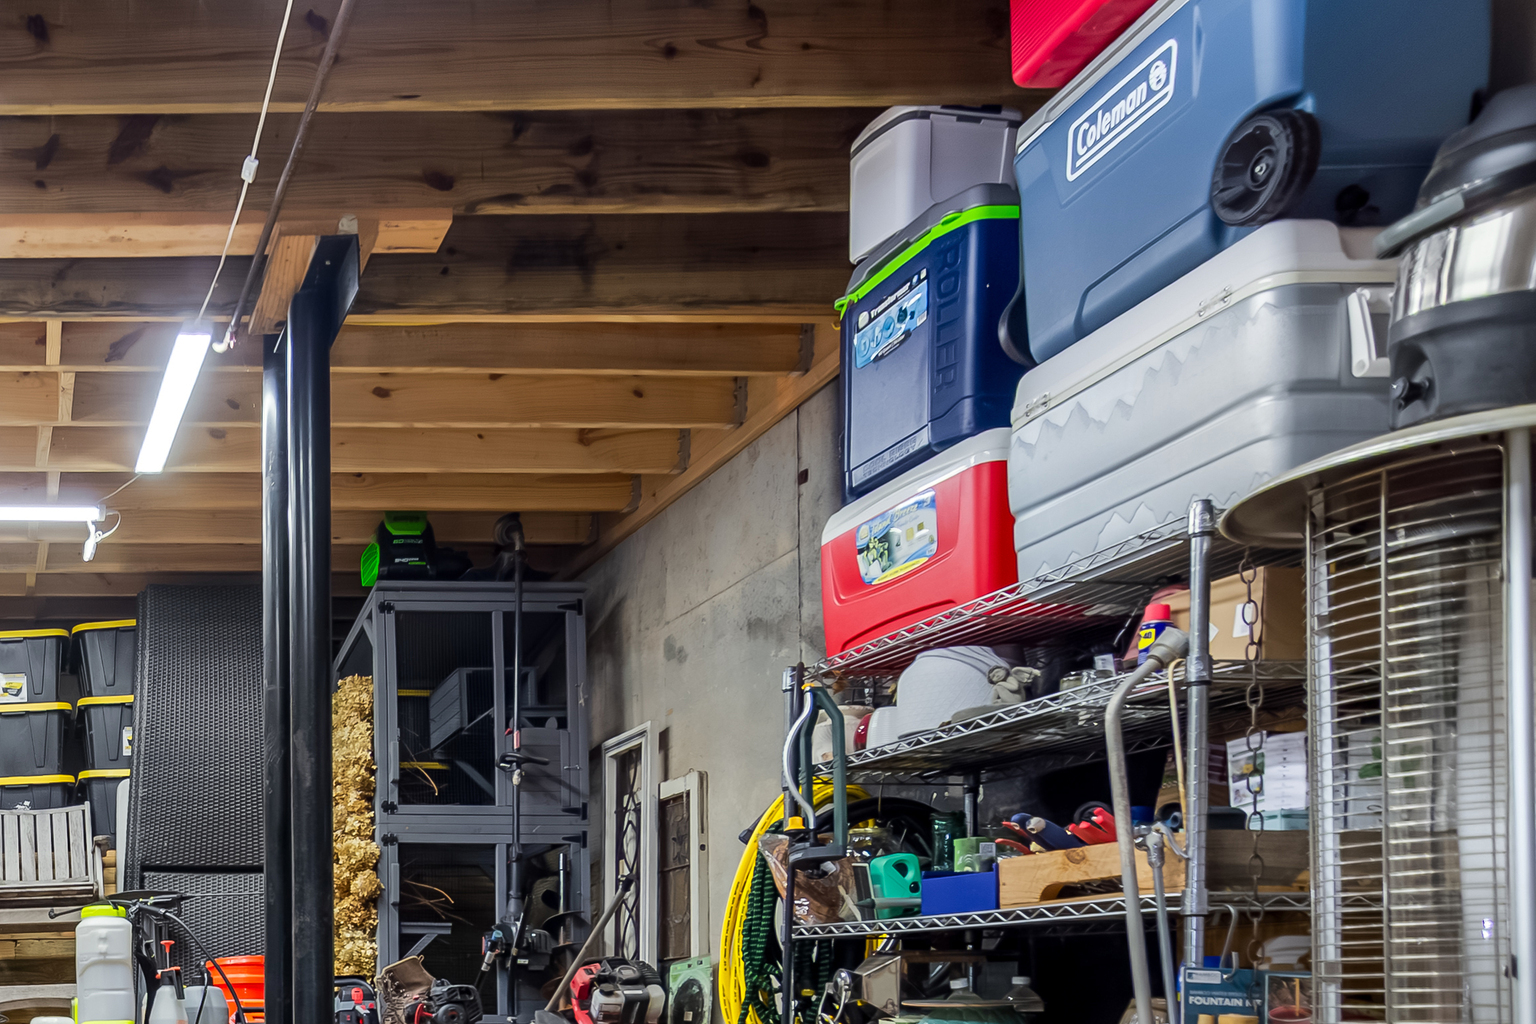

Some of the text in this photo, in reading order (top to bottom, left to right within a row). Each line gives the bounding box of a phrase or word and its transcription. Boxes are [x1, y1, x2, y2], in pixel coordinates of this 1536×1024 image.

[1076, 80, 1148, 156] Coleman
[935, 241, 962, 394] ROLLER
[1188, 996, 1243, 1007] FOUNTAIN
